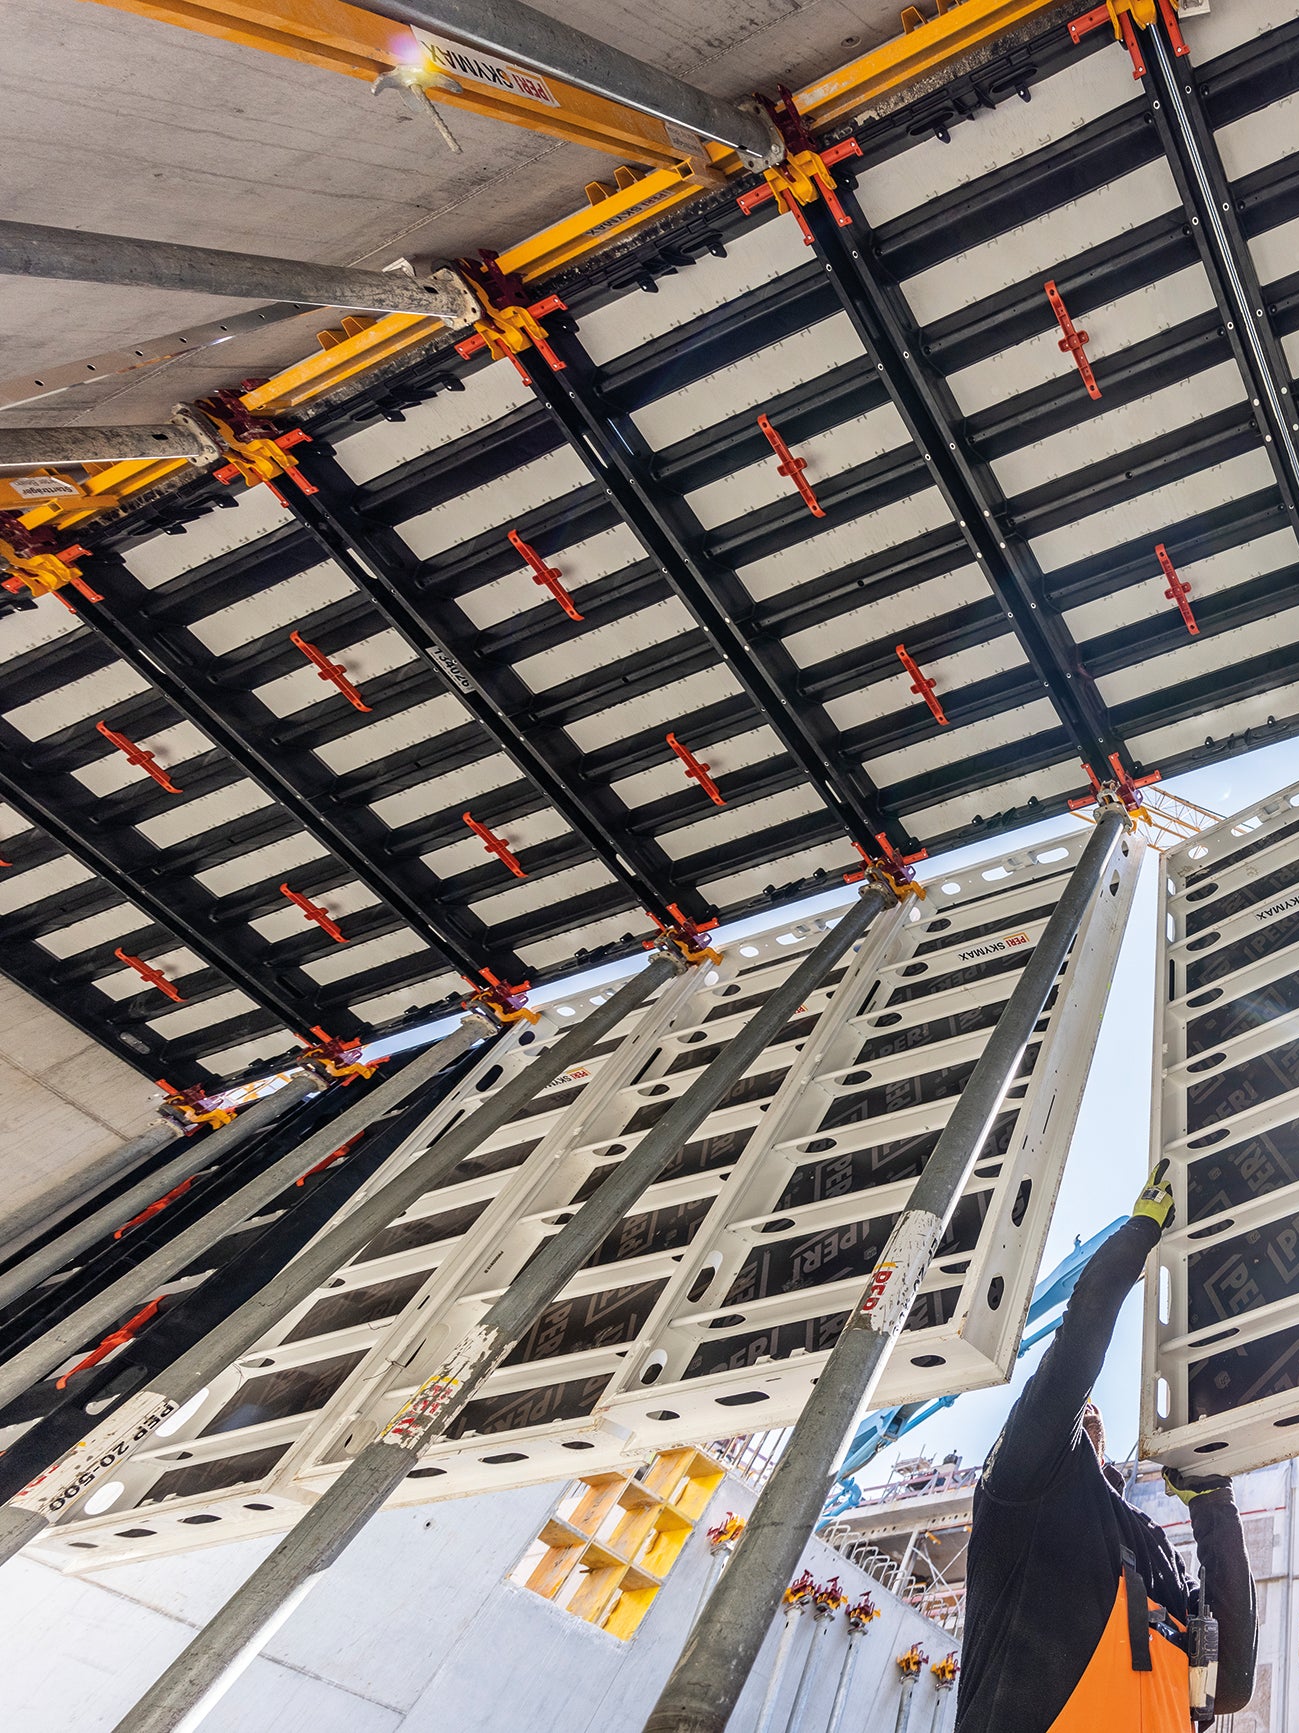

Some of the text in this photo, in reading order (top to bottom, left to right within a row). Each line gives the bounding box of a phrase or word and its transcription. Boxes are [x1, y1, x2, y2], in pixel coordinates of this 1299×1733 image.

[421, 40, 551, 101] PERI SKYMAX
[434, 647, 470, 687] 134026
[959, 935, 1027, 961] PERI SKYMAX
[792, 1222, 858, 1281] PERI
[133, 1402, 175, 1442] PEP
[49, 1440, 131, 1512] 20-500
